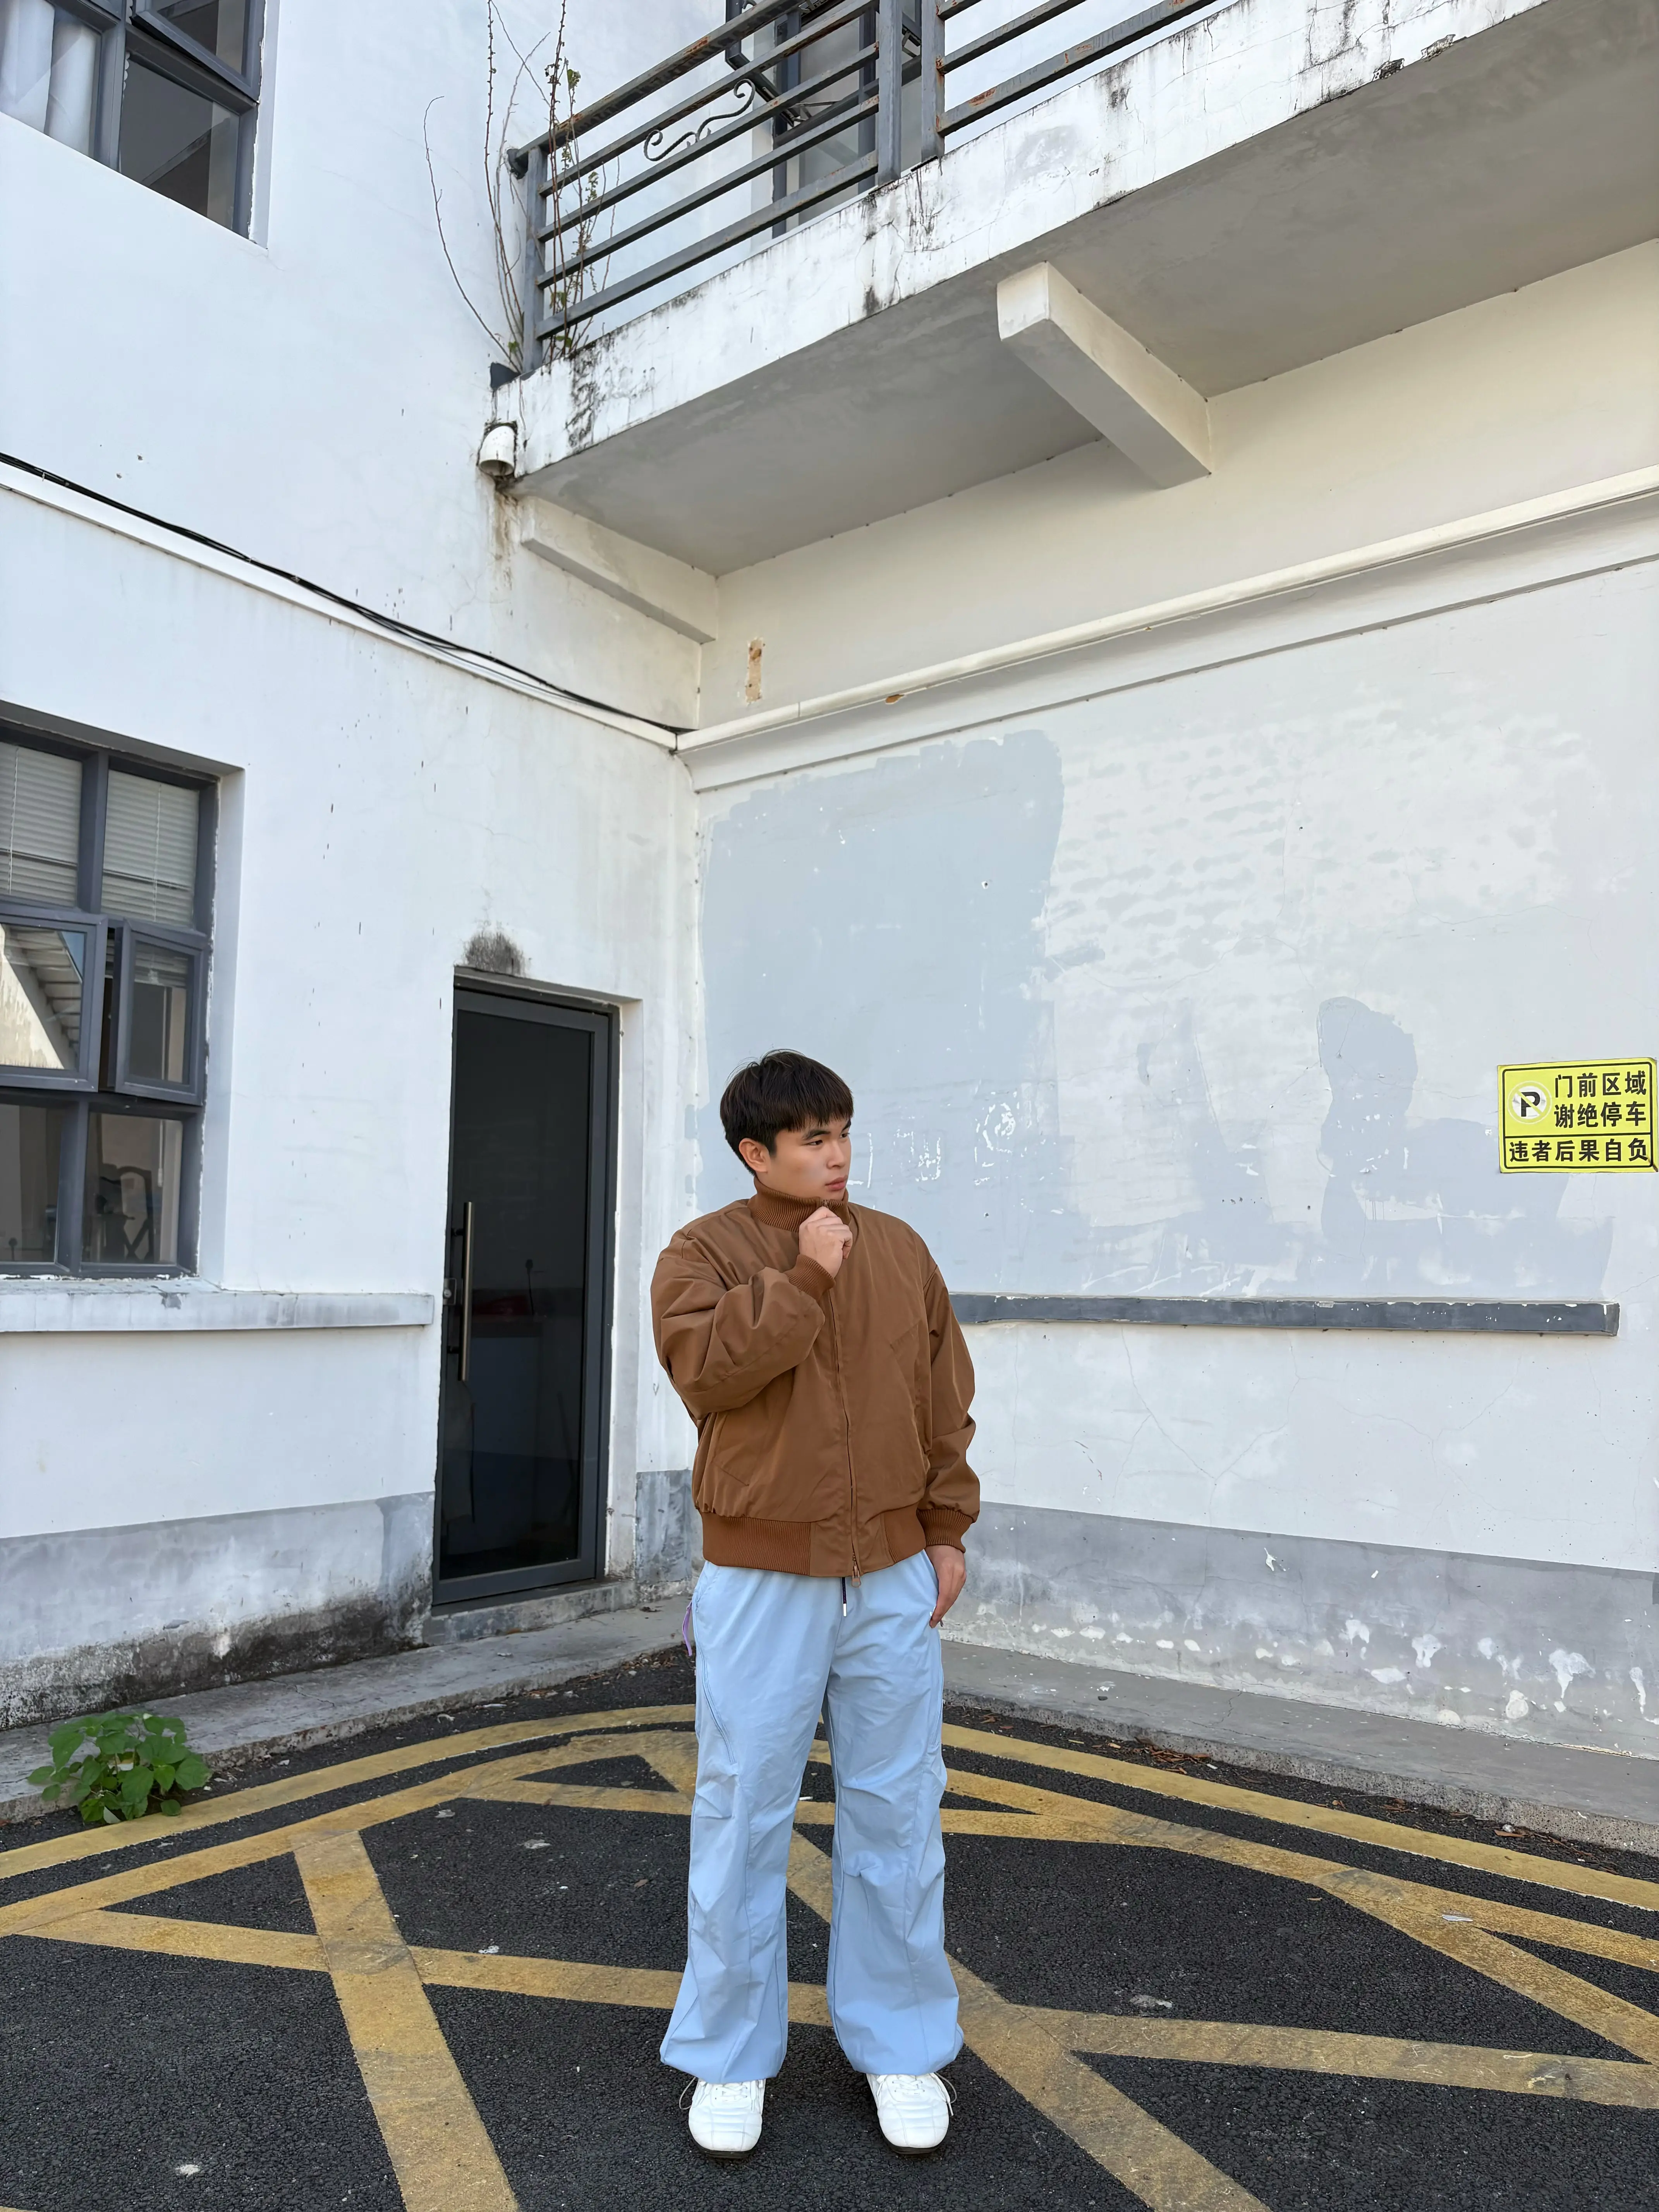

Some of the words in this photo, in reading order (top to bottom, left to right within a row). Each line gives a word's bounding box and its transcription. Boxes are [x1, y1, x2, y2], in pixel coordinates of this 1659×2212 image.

[1555, 1070, 1647, 1098] 门前区域
[1521, 1092, 1540, 1117] P
[1554, 1101, 1646, 1128] 谢绝停车
[1509, 1138, 1648, 1162] 违者后果自负
